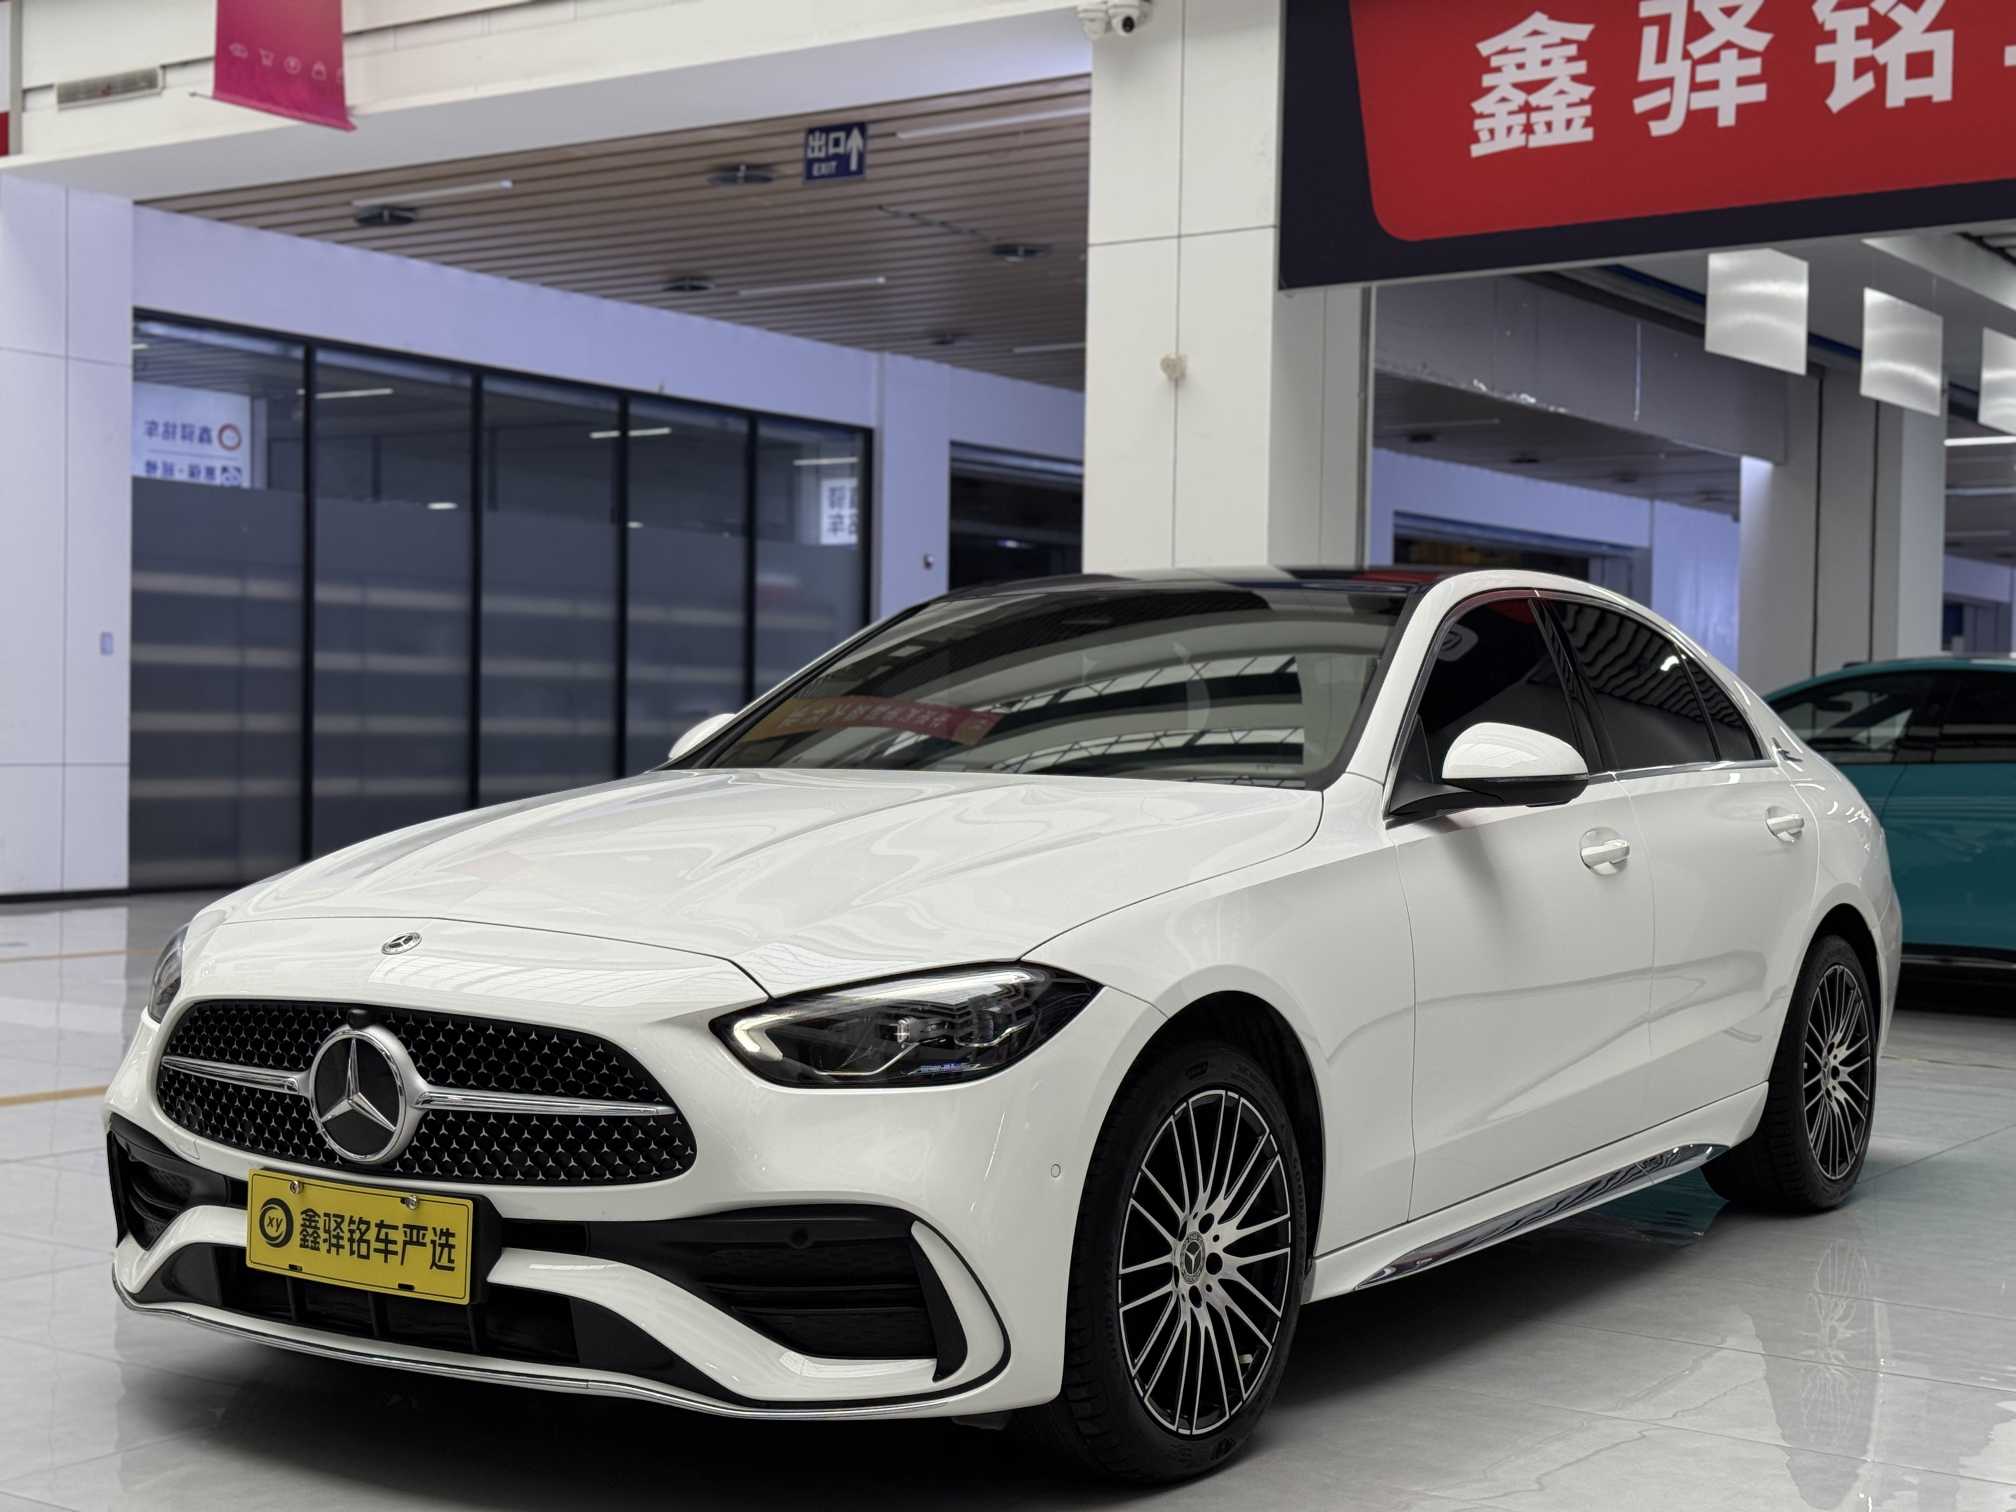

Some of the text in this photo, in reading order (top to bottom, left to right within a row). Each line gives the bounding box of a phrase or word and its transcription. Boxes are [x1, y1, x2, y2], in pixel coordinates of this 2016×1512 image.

[1470, 0, 2016, 158] 鑫驿铭
[808, 131, 847, 159] 出口
[812, 161, 838, 176] EXIT
[299, 1207, 457, 1273] 鑫驿铭车严选
